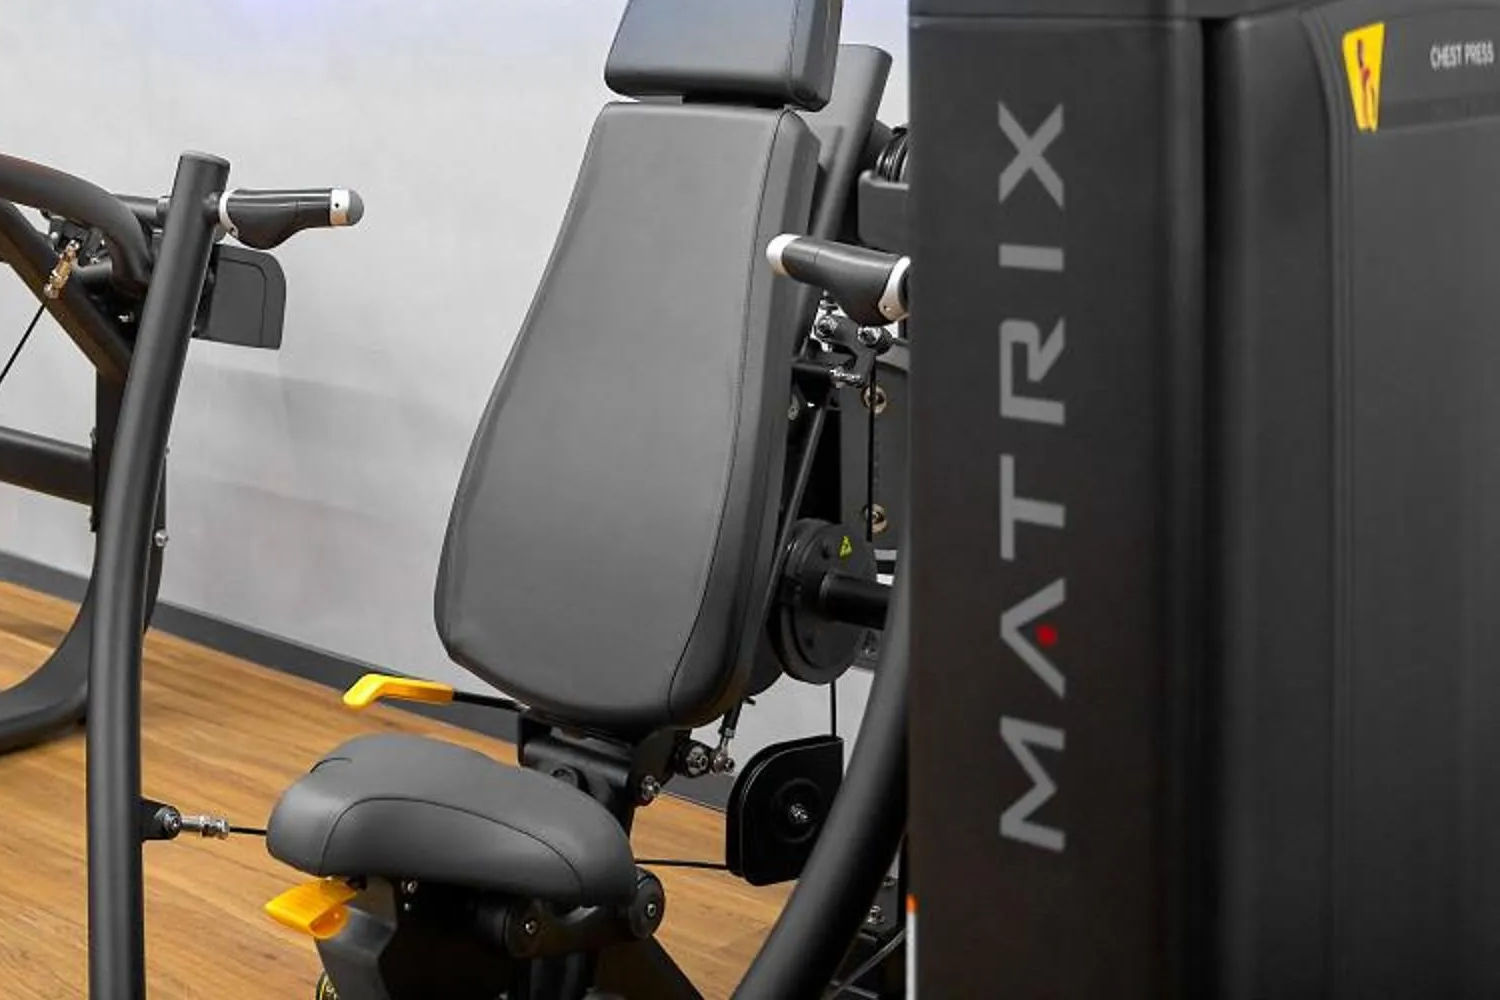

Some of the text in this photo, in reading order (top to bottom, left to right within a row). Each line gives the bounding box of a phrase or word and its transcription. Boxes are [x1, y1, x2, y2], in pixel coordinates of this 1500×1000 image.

[1430, 40, 1495, 71] CHEST PRESS
[999, 102, 1065, 854] MATRIX
